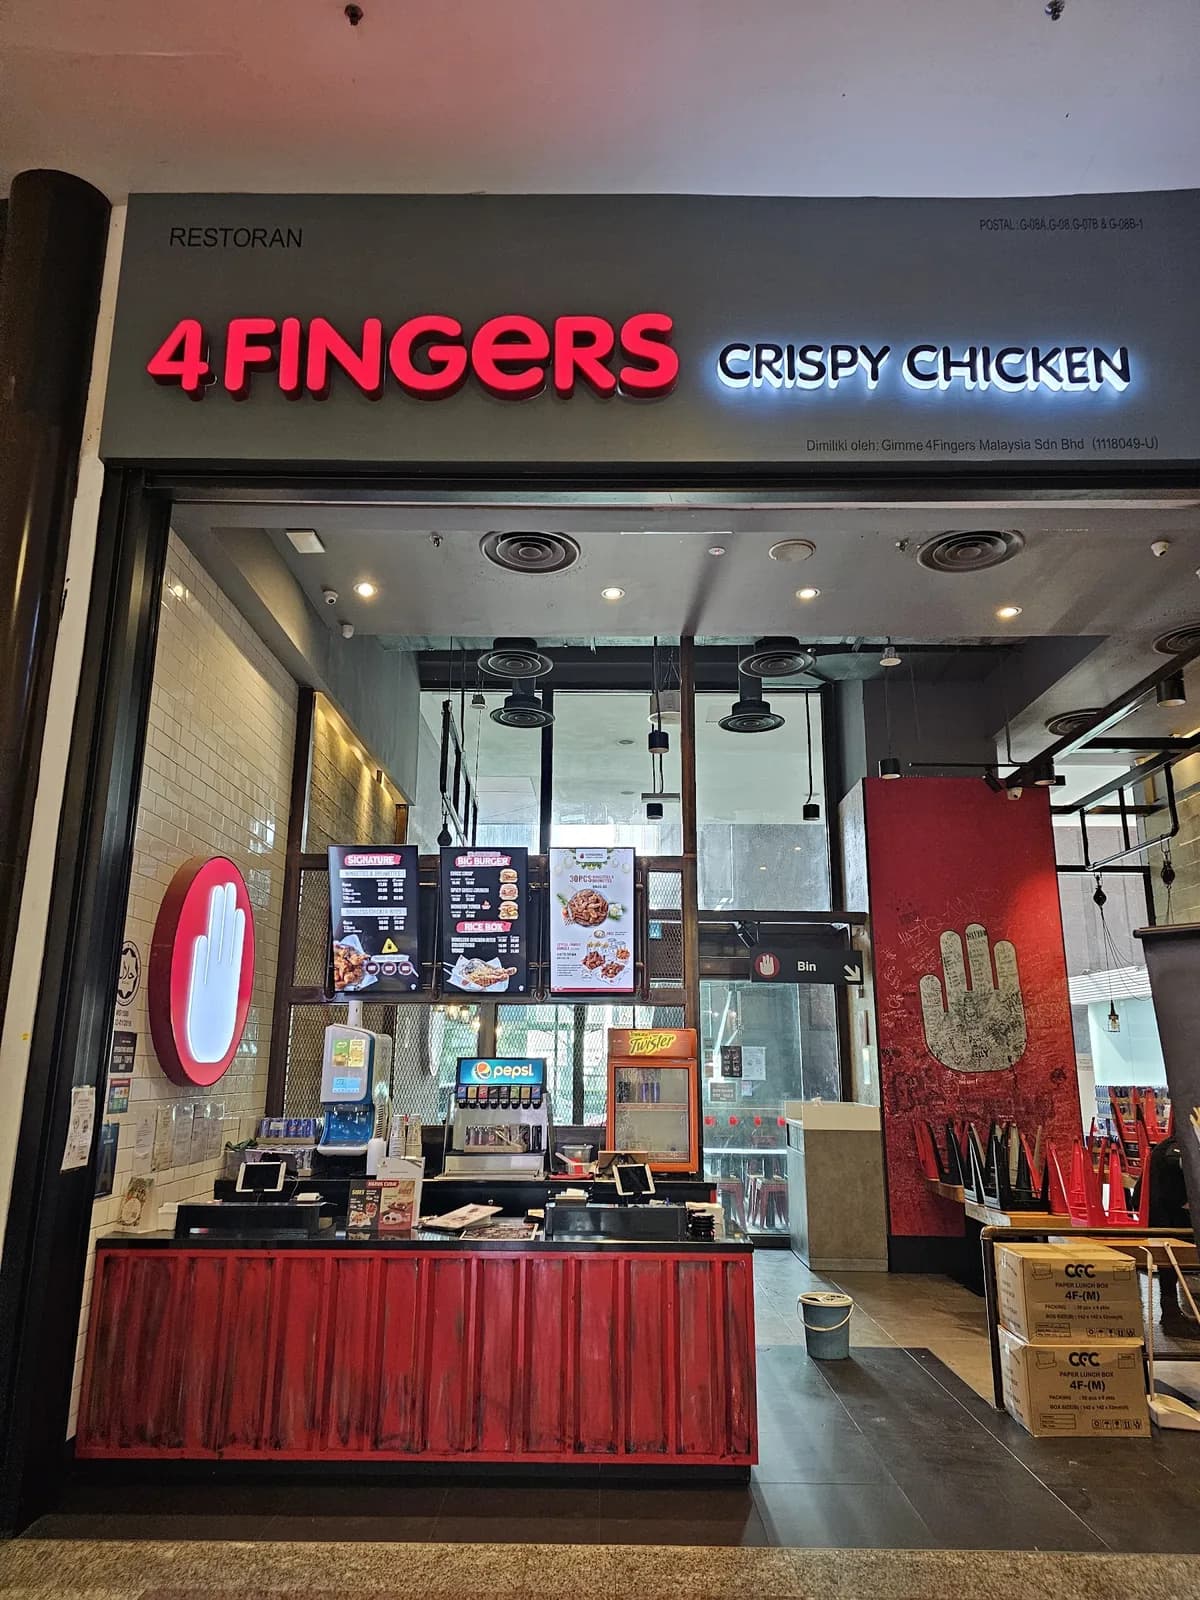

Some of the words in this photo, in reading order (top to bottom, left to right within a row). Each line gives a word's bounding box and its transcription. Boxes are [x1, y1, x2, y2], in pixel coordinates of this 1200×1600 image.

[169, 227, 303, 248] RESTORAN
[717, 342, 891, 389] CRISPY
[903, 344, 1131, 391] CHICKEN
[806, 439, 848, 451] Dimiliki
[850, 439, 879, 451] oleh:
[881, 439, 923, 451] Gimme
[925, 439, 976, 454] 4Fingers
[979, 438, 1031, 453] Malaysia
[1034, 438, 1058, 450] Sdn
[1061, 438, 1085, 450] Bhd
[1092, 437, 1159, 451] (1118049-U)
[348, 855, 394, 865] SIGNATURE
[457, 857, 473, 865] BIG
[474, 857, 508, 865] BURGER
[464, 922, 483, 931] RICE
[797, 961, 817, 972] Bin
[630, 1034, 675, 1054] Twister
[493, 1063, 534, 1079] pepsi
[1065, 1290, 1100, 1301] 4F-(M)
[1070, 1380, 1105, 1392] 4F-(M)
